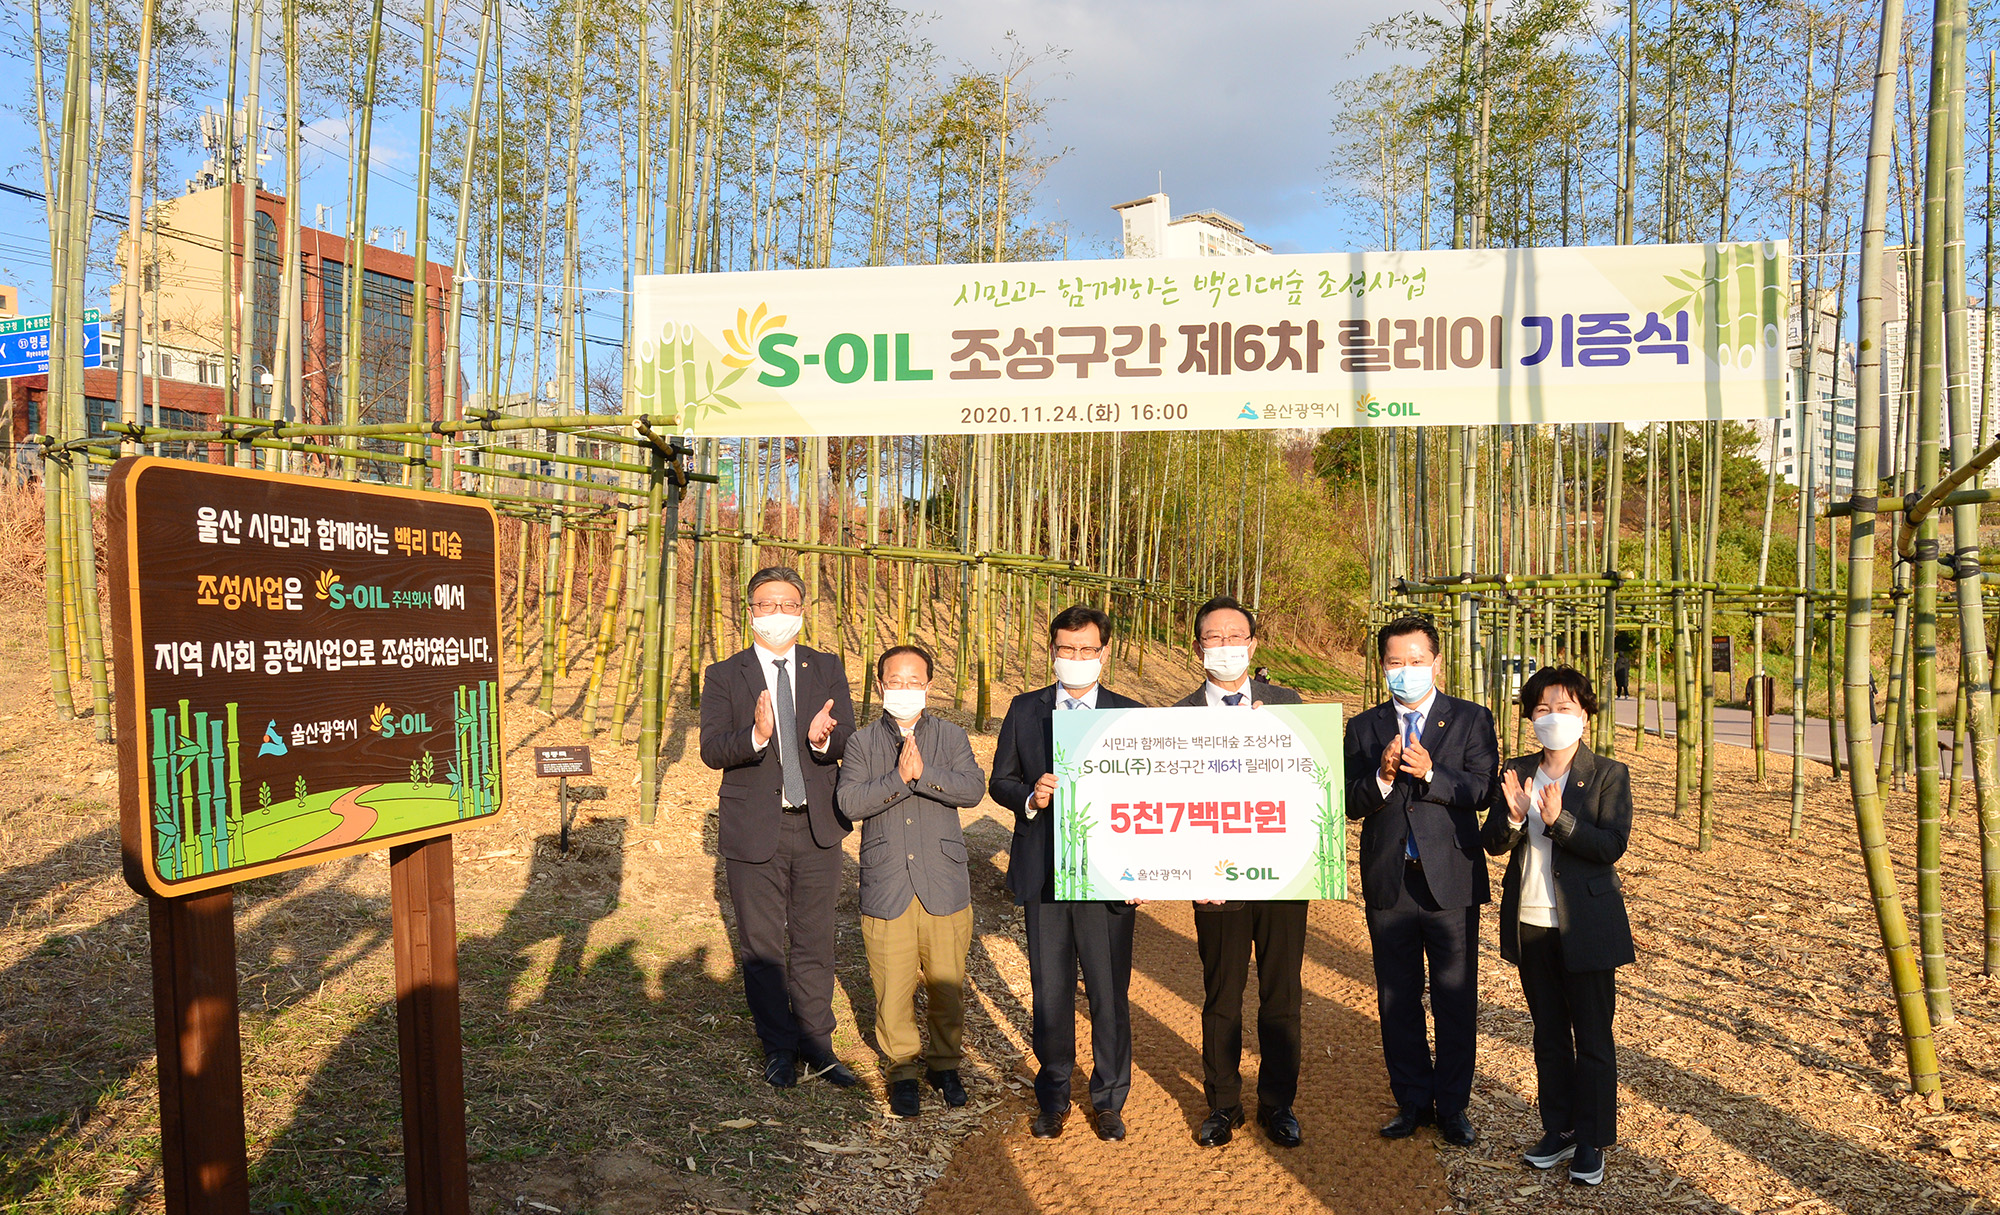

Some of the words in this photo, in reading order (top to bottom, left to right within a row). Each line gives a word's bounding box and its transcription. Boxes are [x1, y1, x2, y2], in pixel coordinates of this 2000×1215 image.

[953, 279, 1046, 307] 시민과
[1058, 276, 1180, 307] 함께하는
[1193, 268, 1304, 308] 백리대숲
[1318, 266, 1427, 301] 조성사업
[757, 332, 934, 388] S-OIL
[949, 323, 1167, 380] 조성구간
[1177, 319, 1325, 376] 제6차
[1338, 314, 1503, 373] 릴레이
[1520, 310, 1690, 368] 기증식
[960, 403, 1120, 424] 2020.11.24.(화)
[1131, 402, 1189, 421] 16:00
[1262, 401, 1340, 419] 울산광역시
[1366, 402, 1421, 418] S-OIL
[197, 506, 242, 545] 울산
[248, 513, 311, 548] 시민과
[316, 518, 390, 555] 함께하는
[394, 526, 427, 557] 백리
[432, 530, 463, 560] 대숲
[197, 574, 303, 611] 조성사업은
[329, 582, 390, 609] S-OIL
[392, 590, 432, 609] 주식회사
[434, 584, 465, 611] 에서
[154, 640, 203, 677] 지역
[211, 640, 255, 673] 사회
[263, 638, 376, 675] 공헌사업으로
[381, 636, 493, 669] 조성하였습니다.
[290, 718, 358, 746] 울산광역시
[381, 713, 433, 739] S-OIL
[1102, 736, 1138, 750] 시민과
[1141, 736, 1189, 750] 함께하는
[1191, 735, 1240, 749] 백리대숲
[1243, 734, 1292, 748] 조성사업
[1083, 757, 1152, 776] S-OIL(주)
[1153, 759, 1205, 774] 조성구간
[1207, 758, 1242, 774] 제6차
[1245, 757, 1284, 774] 릴레이
[1287, 757, 1314, 773] 기증
[1110, 800, 1287, 835] 5천7백만원
[1137, 868, 1192, 882] 울산광역시
[1225, 867, 1280, 881] S-OIL
